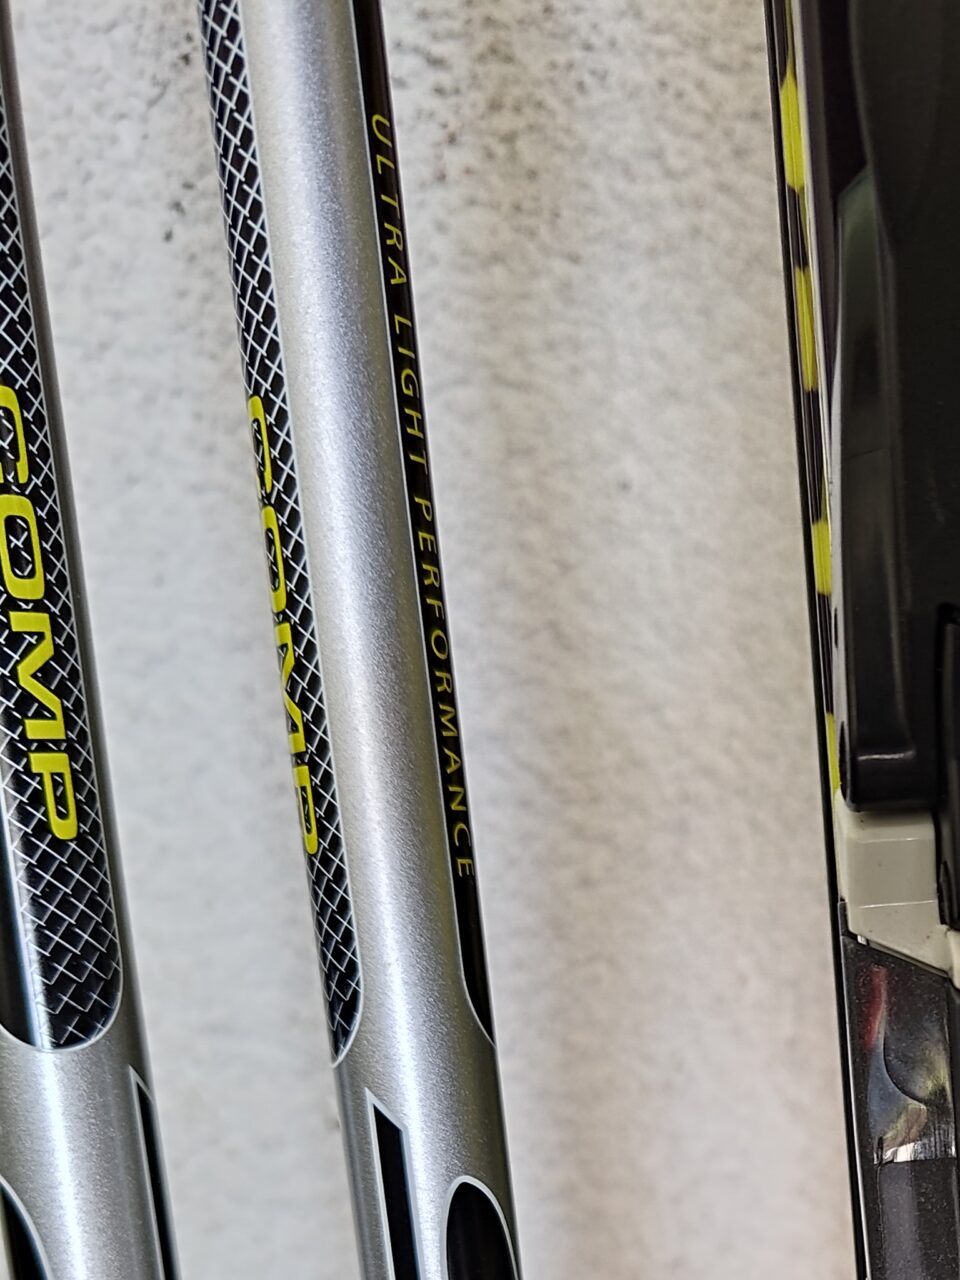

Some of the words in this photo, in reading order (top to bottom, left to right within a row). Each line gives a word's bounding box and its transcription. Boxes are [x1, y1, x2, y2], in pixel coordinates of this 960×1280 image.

[0, 384, 79, 840] COMP
[371, 113, 408, 286] ULTRA
[394, 312, 429, 476] LIGHT
[413, 495, 476, 878] PERFORMANCE
